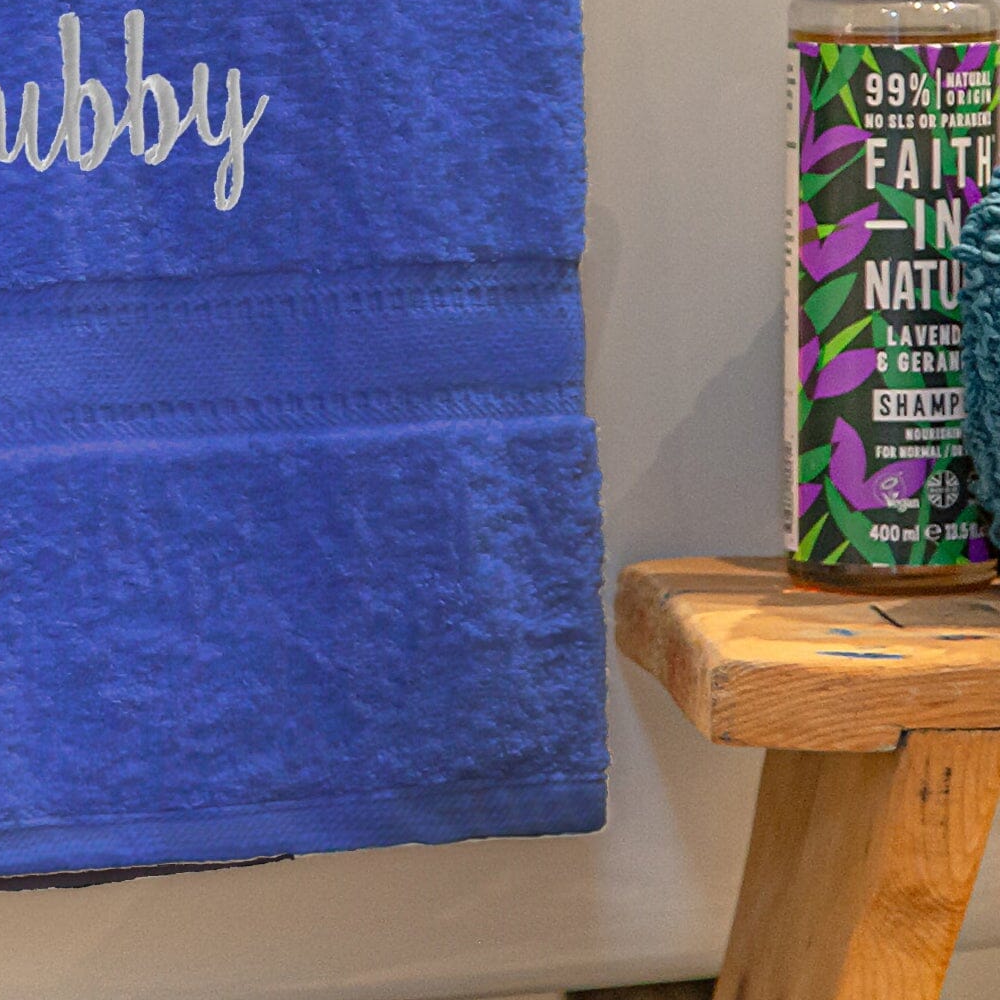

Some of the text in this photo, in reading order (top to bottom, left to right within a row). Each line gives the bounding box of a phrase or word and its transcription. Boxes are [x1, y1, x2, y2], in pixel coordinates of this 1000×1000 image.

[865, 73, 930, 107] 99%
[946, 71, 991, 88] NATURAL
[946, 88, 992, 106] ORIGIN
[865, 113, 884, 128] NO
[888, 114, 915, 129] SLS
[918, 114, 936, 129] OR
[866, 136, 992, 189] FAITH
[865, 259, 966, 310] NATU
[887, 324, 961, 346] LAVEND
[898, 351, 964, 373] GERAN
[879, 393, 960, 416] SHAMP
[874, 445, 897, 458] FOR
[899, 445, 941, 458] NORMAL
[869, 524, 900, 541] 400
